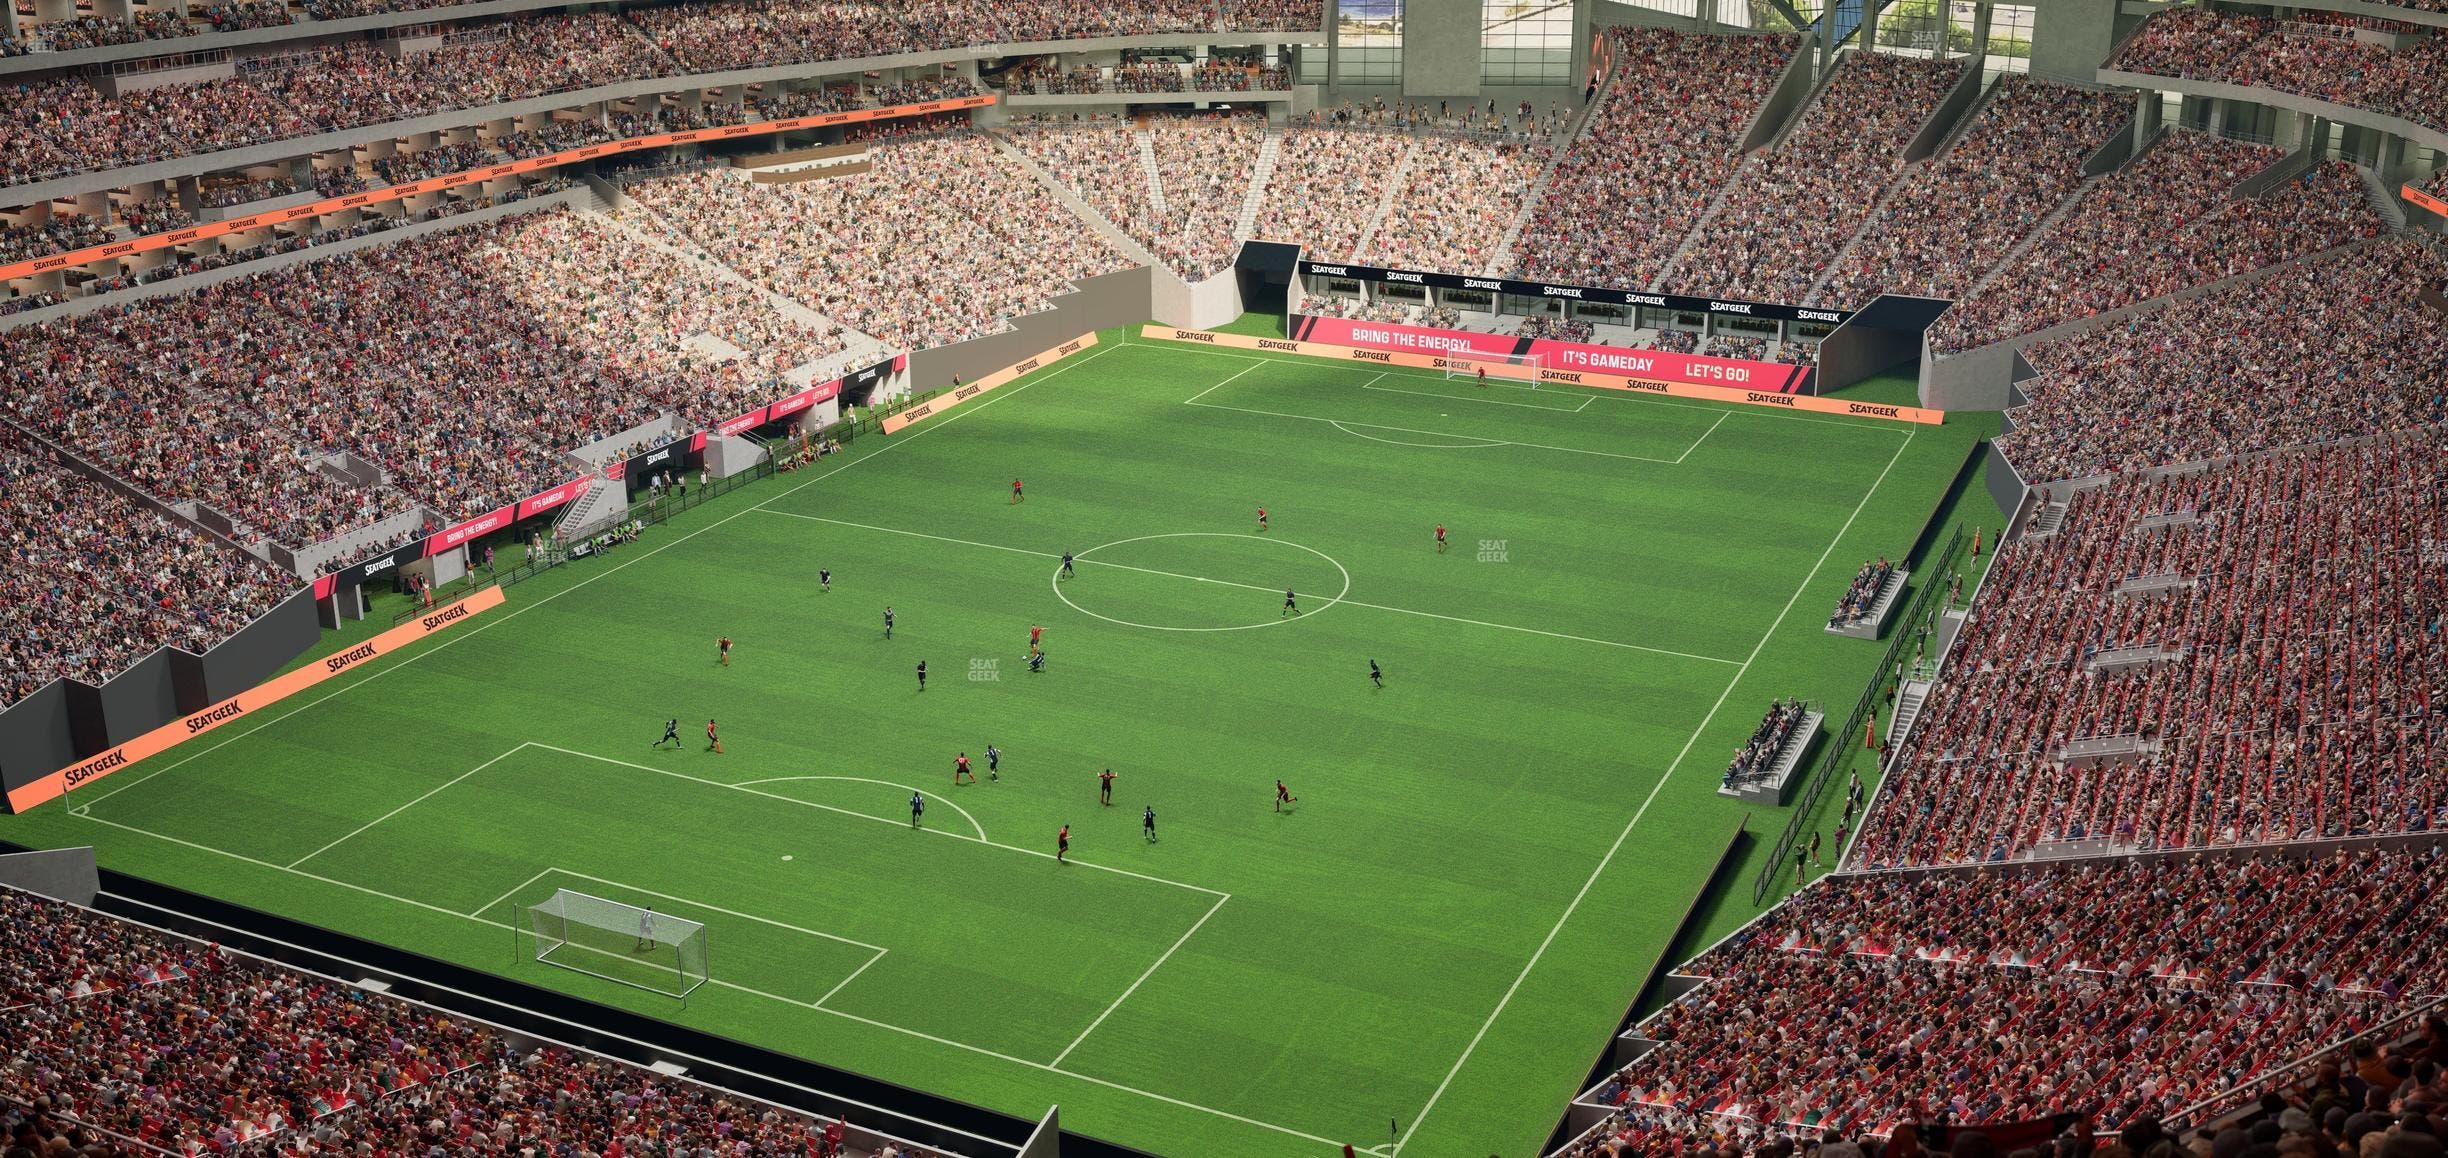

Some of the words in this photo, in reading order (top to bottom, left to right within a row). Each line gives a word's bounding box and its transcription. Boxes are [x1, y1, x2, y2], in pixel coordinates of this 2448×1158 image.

[228, 217, 258, 231] SEATGEEK
[167, 229, 198, 243] SEATGEEK
[102, 243, 135, 257] SEATGEEK
[33, 257, 68, 271] SEATGEEK
[1311, 264, 1347, 277] SEATGEEK
[1386, 271, 1424, 284] SEATGEEK
[1463, 278, 1502, 291] SEATGEEK
[1543, 285, 1582, 299] SEATGEEK
[1625, 293, 1666, 306] SEATGEEK
[1710, 301, 1752, 315] SEATGEEK
[1797, 309, 1840, 323] SEATGEEK
[1175, 330, 1215, 343] SEATGEEK
[1352, 327, 1390, 344] BRING
[1393, 332, 1416, 347] THE
[1418, 334, 1471, 352] ENERGY!
[1058, 340, 1082, 357] SEATGEEK
[1258, 339, 1298, 352] SEATGEEK
[1352, 349, 1391, 362] SEATGEEK
[1562, 350, 1588, 365] IT'S
[1590, 352, 1655, 372] GAMEDAY
[1015, 358, 1040, 375] SEATGEEK
[1432, 358, 1472, 371] SEATGEEK
[1540, 369, 1582, 383] SEATGEEK
[1685, 362, 1723, 380] LET'S
[1725, 367, 1750, 382] GO!
[955, 383, 981, 401] SEATGEEK
[1626, 379, 1669, 393] SEATGEEK
[1746, 392, 1795, 408] SEATGEEK
[904, 404, 932, 423] SEATGEEK
[1848, 403, 1899, 418] SEATGEEK
[446, 529, 465, 543] BRING
[464, 525, 476, 537] THE
[475, 516, 498, 532] ENERGY!
[364, 554, 396, 576] SEATGEEK
[422, 602, 470, 632] SEATGEEK
[326, 641, 377, 673] SEATGEEK
[186, 699, 243, 734] SEATGEEK
[64, 749, 128, 786] SEATGEEK
